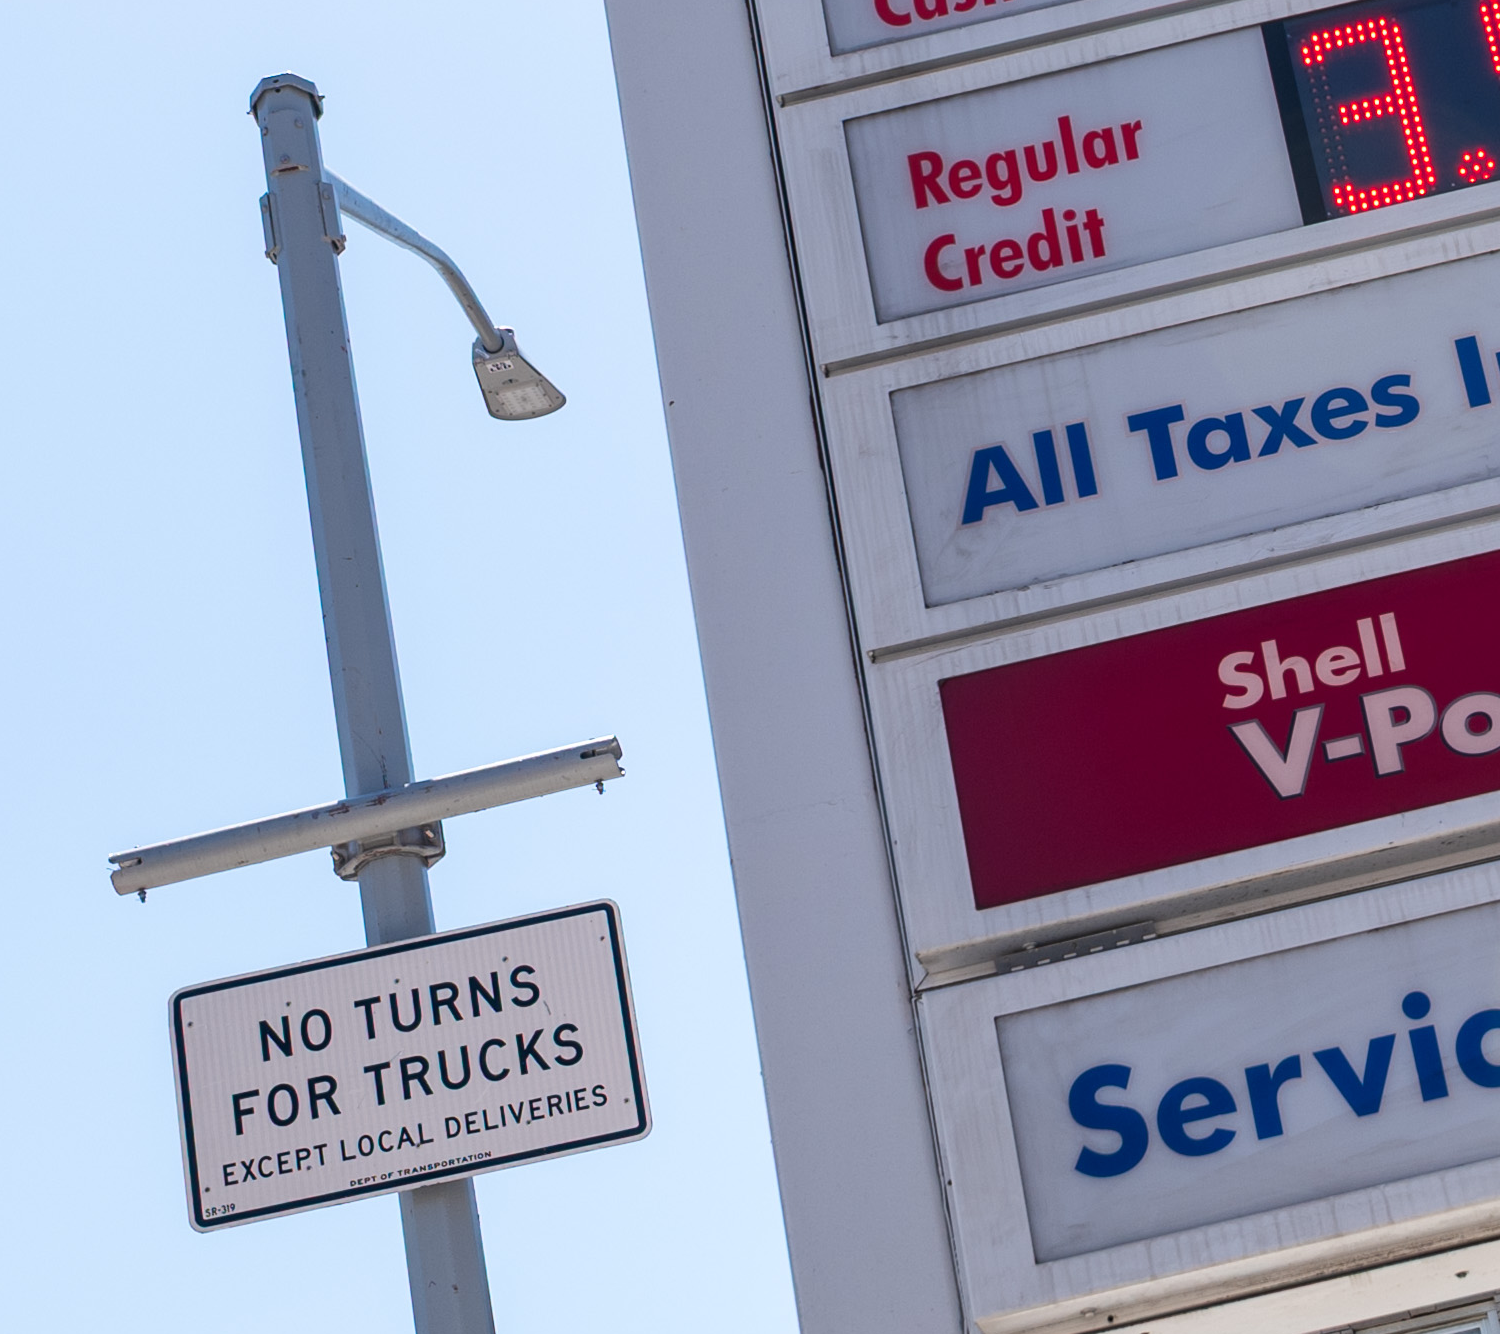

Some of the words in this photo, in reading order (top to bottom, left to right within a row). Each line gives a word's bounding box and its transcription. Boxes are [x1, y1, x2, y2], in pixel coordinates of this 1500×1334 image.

[907, 111, 1144, 209] Regular
[922, 204, 1107, 293] Credit
[959, 421, 1098, 526] All
[1128, 370, 1421, 483] Taxes
[1218, 611, 1407, 710] Shell
[259, 1008, 333, 1062] NO
[354, 964, 541, 1040] TURNS
[231, 1074, 341, 1136] FOR
[364, 1022, 584, 1106] TRUCKS
[222, 1144, 328, 1187] EXCEPT
[340, 1123, 434, 1160] LOCAL
[445, 1083, 609, 1139] DELIVERIES
[349, 1175, 376, 1187] DEPT
[380, 1171, 395, 1182] OF
[396, 1150, 492, 1177] TRANSPORTATION
[204, 1201, 237, 1218] SR-319
